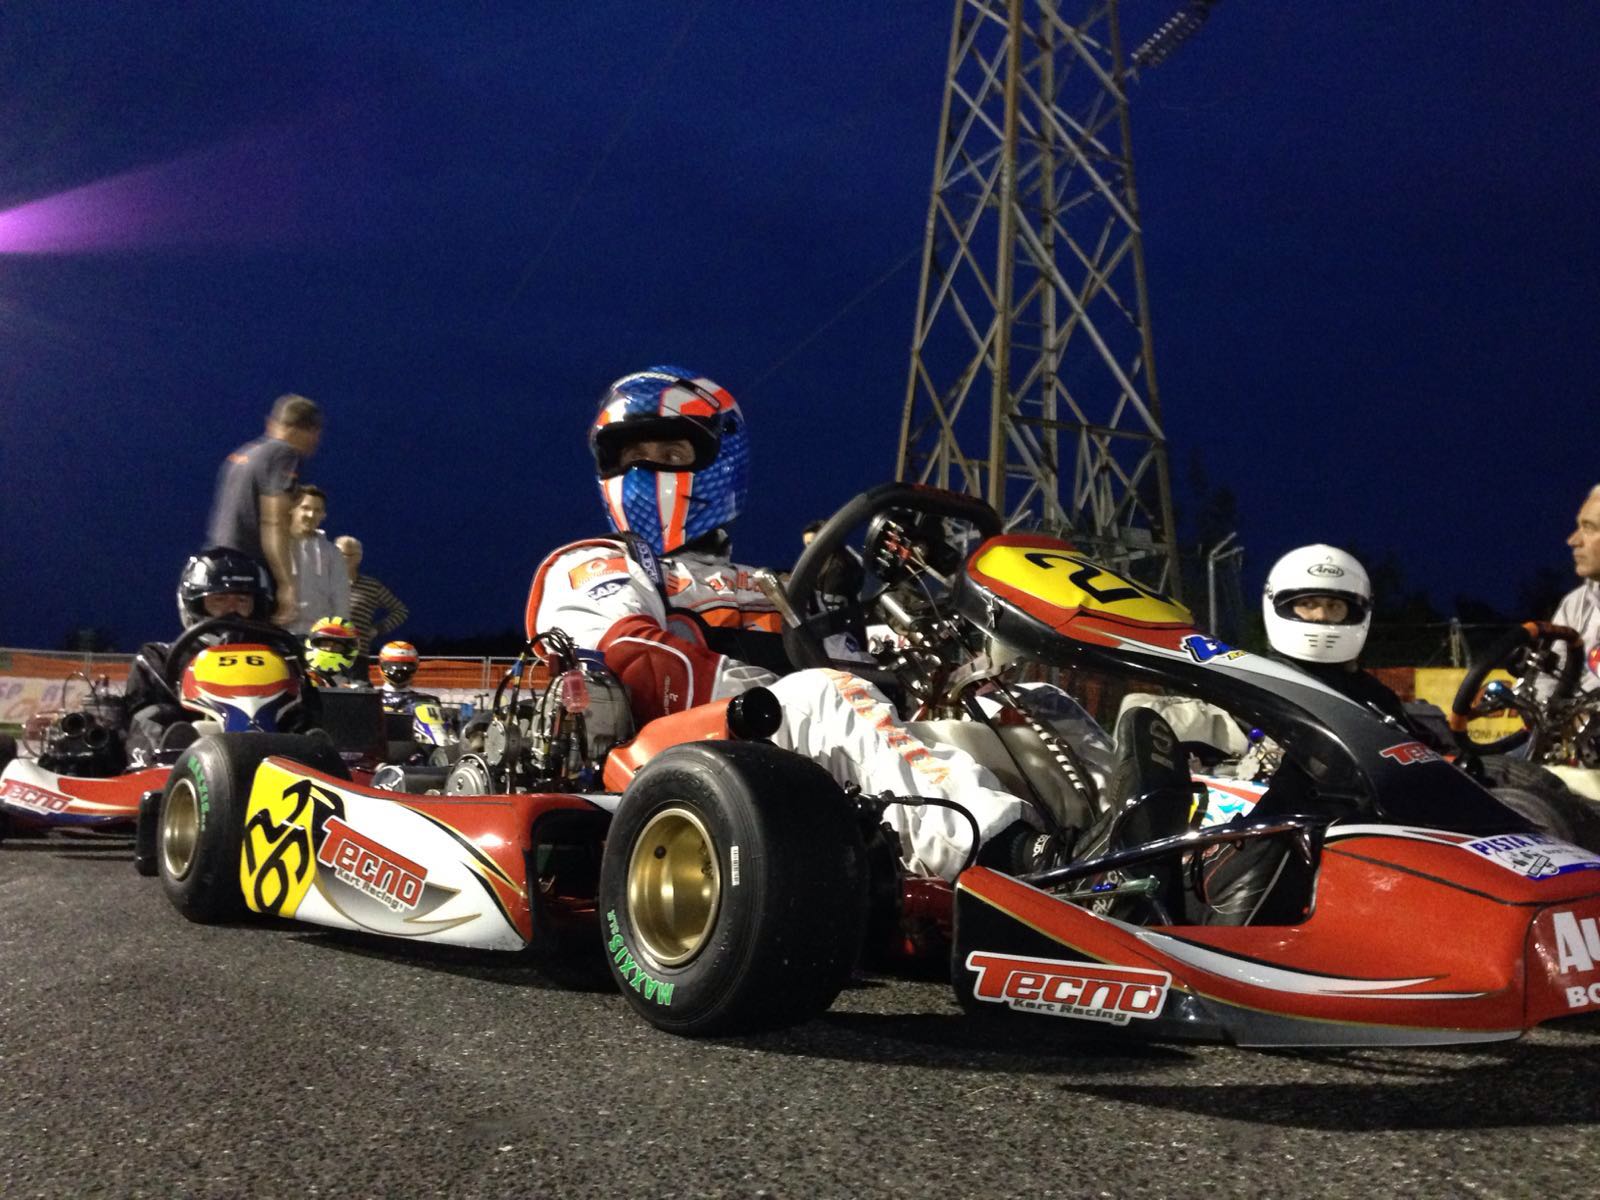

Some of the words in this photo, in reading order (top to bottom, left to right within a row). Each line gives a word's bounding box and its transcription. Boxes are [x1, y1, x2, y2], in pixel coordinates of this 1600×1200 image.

[1314, 564, 1340, 575] Arai
[0, 778, 74, 811] Tecno
[317, 818, 428, 908] Tecno
[1470, 836, 1535, 856] PISTA
[336, 867, 365, 889] Kart
[361, 880, 404, 909] Racing
[608, 934, 675, 1006] MAXXIS
[969, 955, 1168, 1014] Tecno
[1013, 998, 1054, 1014] Kart
[1060, 1003, 1128, 1022] Racing
